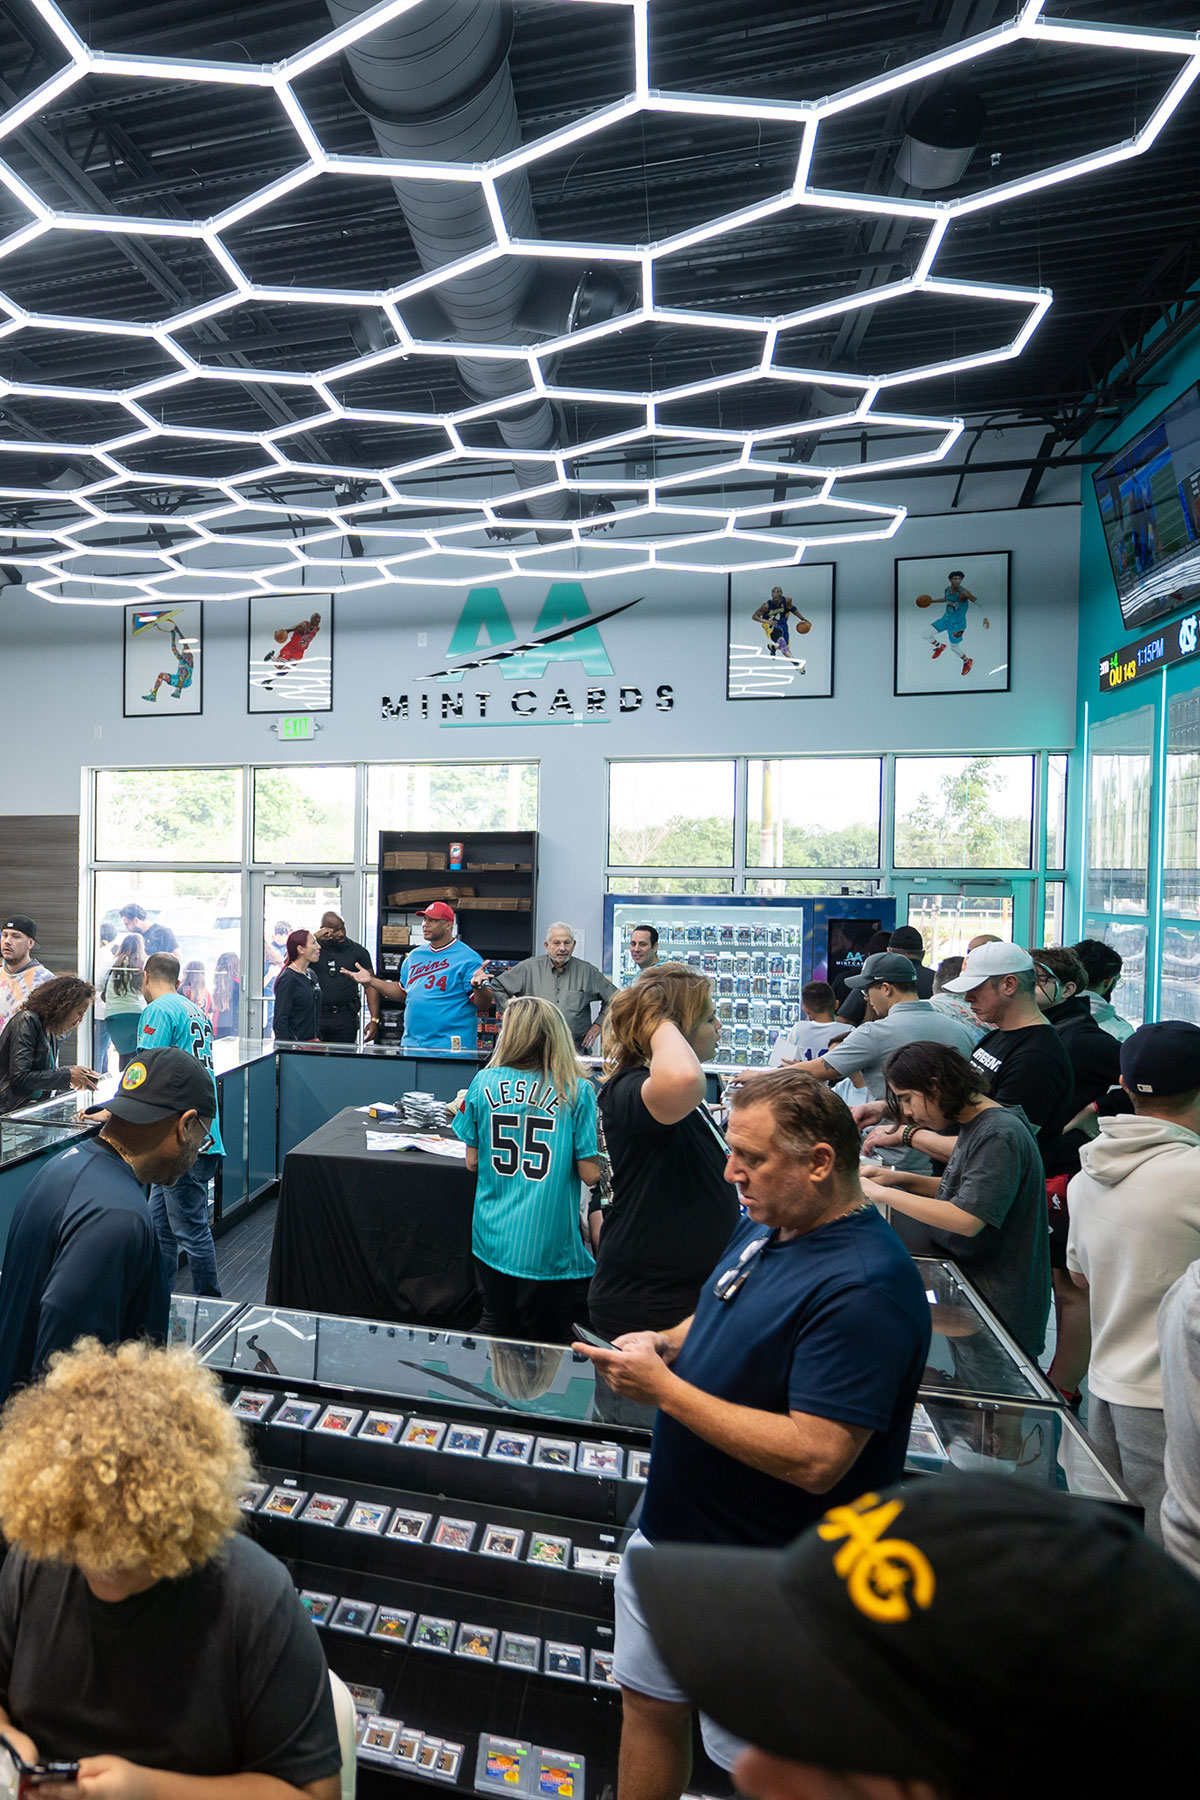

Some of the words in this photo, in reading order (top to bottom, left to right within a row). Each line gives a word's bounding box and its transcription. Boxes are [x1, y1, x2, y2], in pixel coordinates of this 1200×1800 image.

[436, 582, 615, 683] AA
[1137, 637, 1164, 667] 1:15PM
[1123, 660, 1136, 681] 143
[380, 691, 491, 721] MINT
[511, 685, 674, 715] CARDS
[284, 717, 310, 738] EXIT
[408, 958, 450, 979] Twins
[424, 975, 448, 992] 34
[484, 1079, 561, 1118] LESLIE
[490, 1112, 556, 1182] 55
